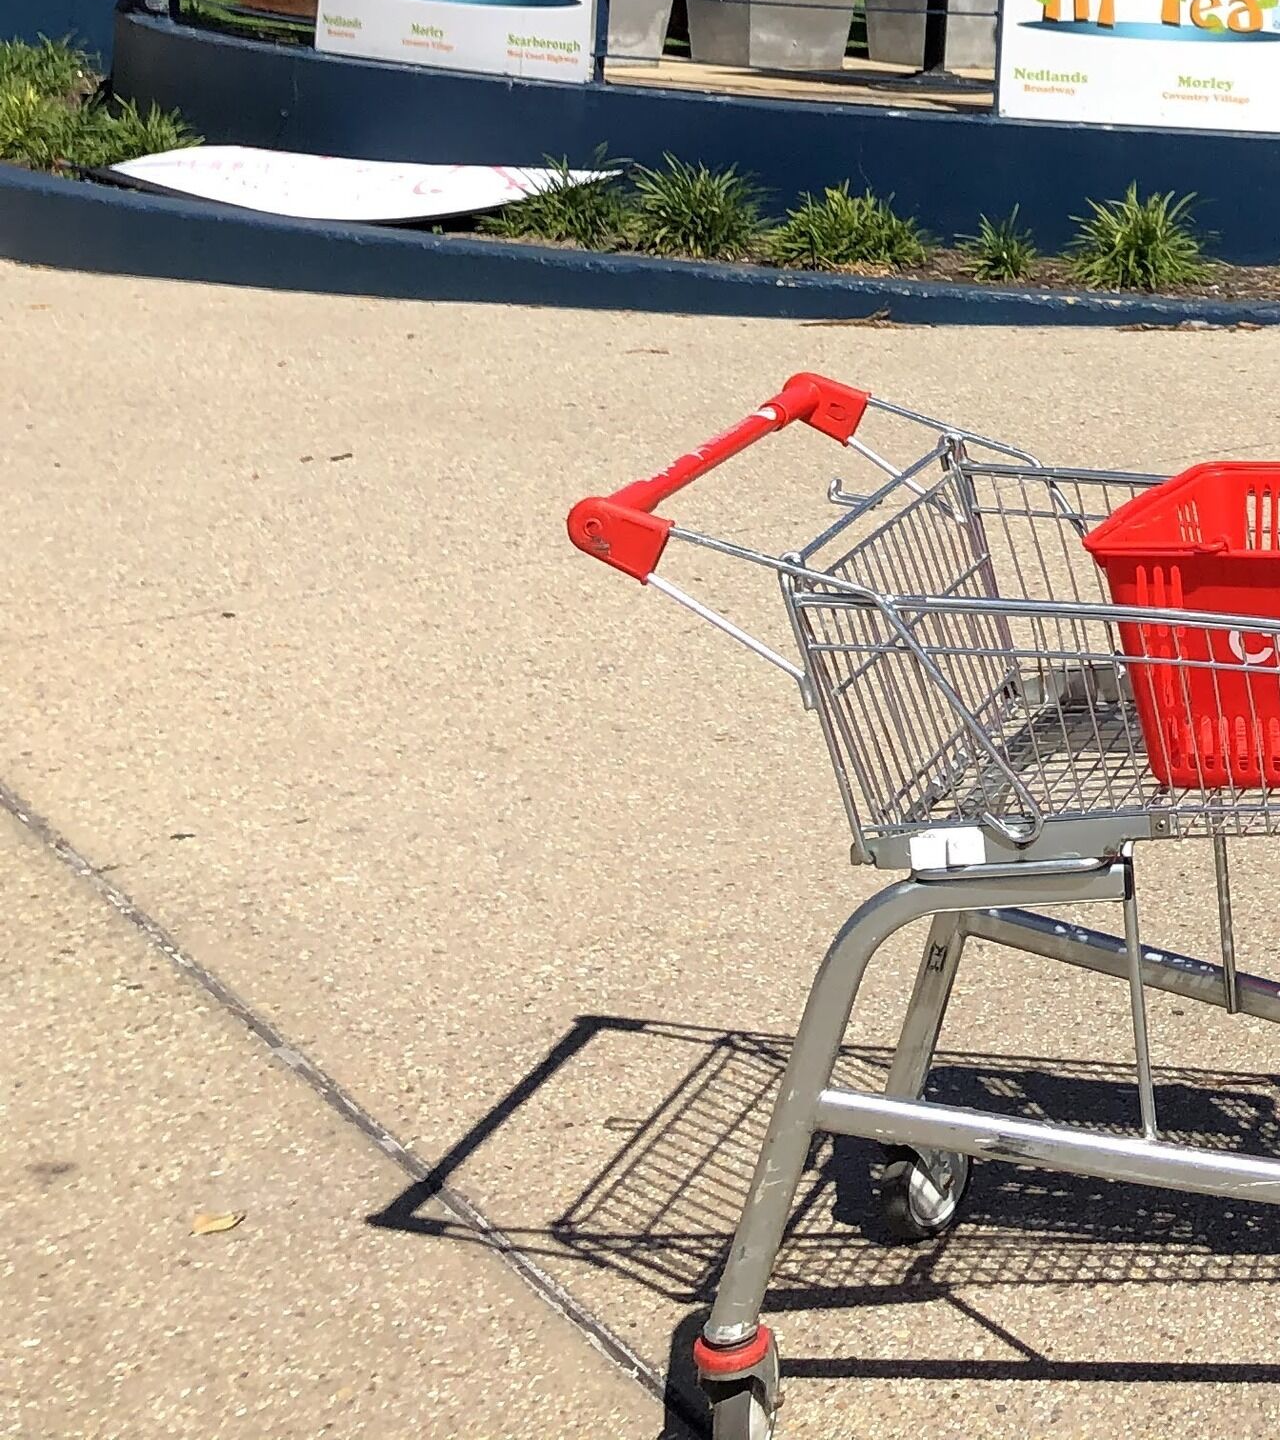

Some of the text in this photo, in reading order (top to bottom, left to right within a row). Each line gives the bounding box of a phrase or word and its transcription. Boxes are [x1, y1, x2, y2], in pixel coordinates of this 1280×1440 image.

[507, 33, 582, 53] Scarborough
[1014, 66, 1089, 85] Nedlands
[1177, 74, 1235, 92] Morley
